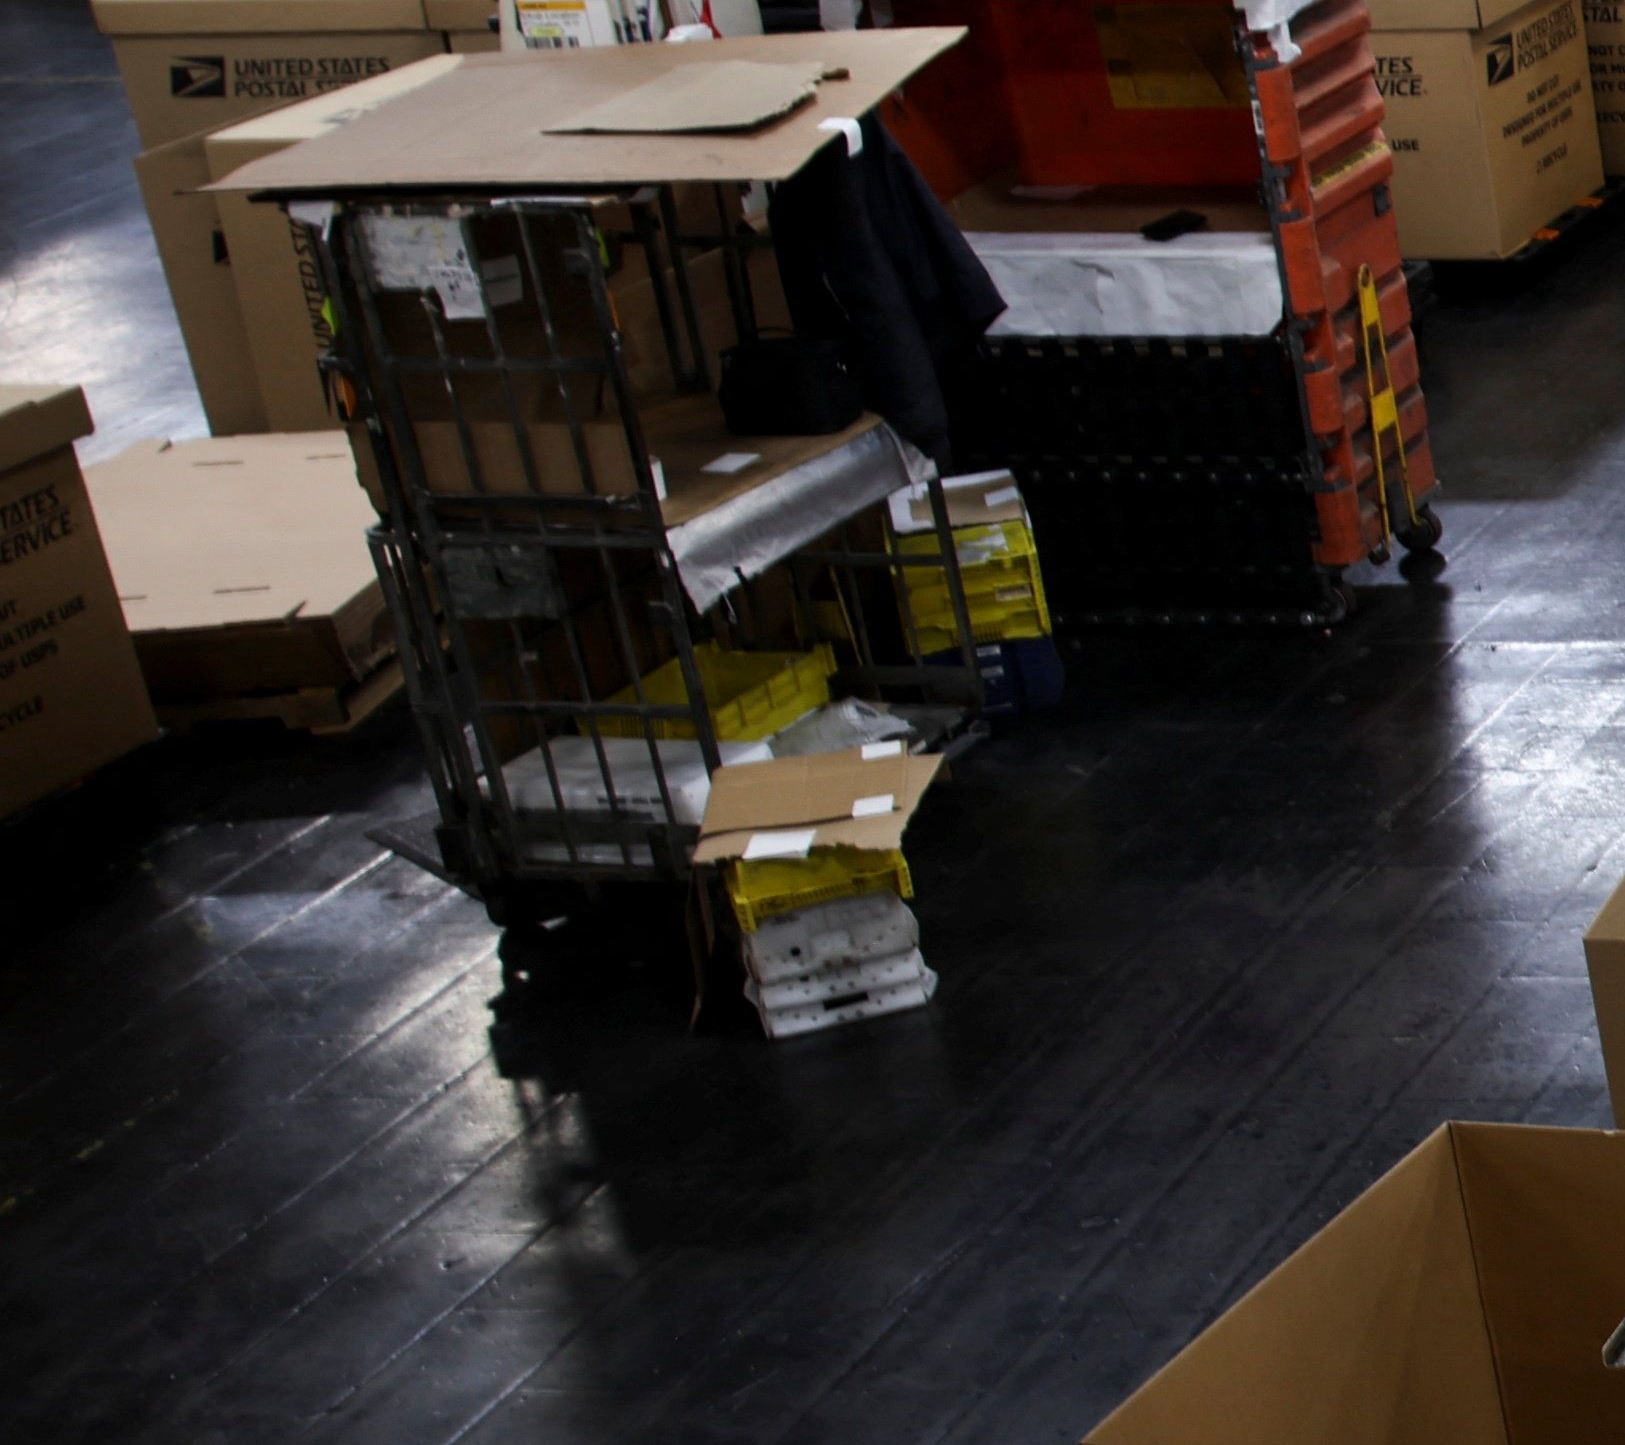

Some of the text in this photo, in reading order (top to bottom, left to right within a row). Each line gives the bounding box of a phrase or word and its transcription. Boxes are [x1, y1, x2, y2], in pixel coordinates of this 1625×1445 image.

[234, 57, 391, 77] UNITED STATES
[234, 81, 307, 97] POSTAL
